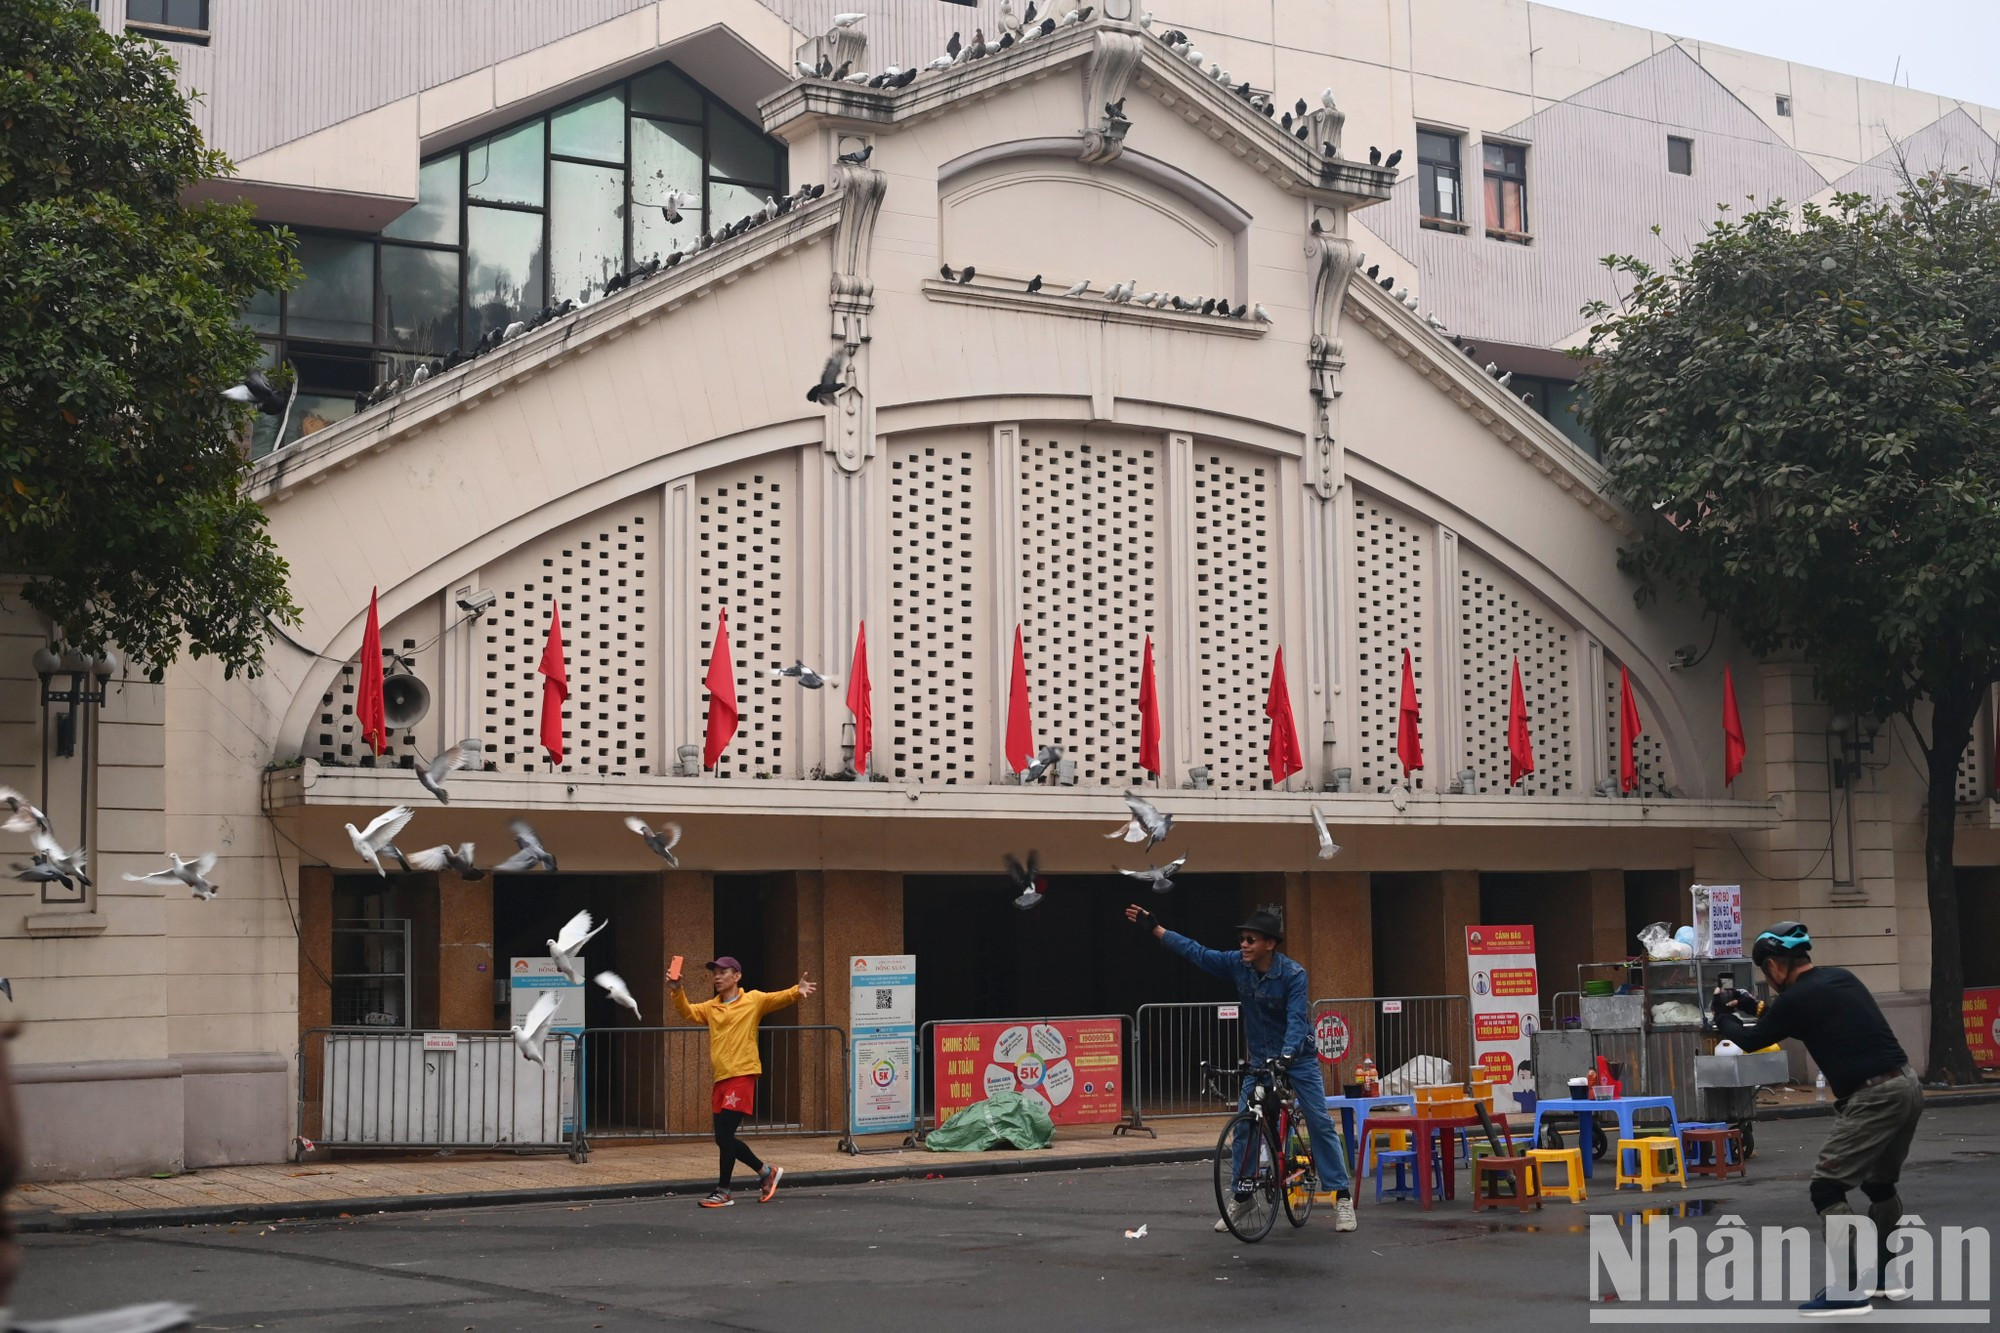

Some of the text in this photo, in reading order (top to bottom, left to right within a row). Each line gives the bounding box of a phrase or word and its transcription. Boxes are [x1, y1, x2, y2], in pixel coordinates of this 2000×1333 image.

[1494, 930, 1521, 939] CẢNH BÁO
[1481, 1026, 1492, 1035] TRIỆU
[1507, 1025, 1519, 1034] TRIỆU
[941, 1036, 962, 1052] CHUNG
[964, 1032, 980, 1052] SỐNG
[948, 1057, 974, 1075] AN TOÀN
[879, 1072, 888, 1080] 5K
[1020, 1067, 1039, 1079] 5K
[950, 1081, 972, 1101] VỚI ĐẠI
